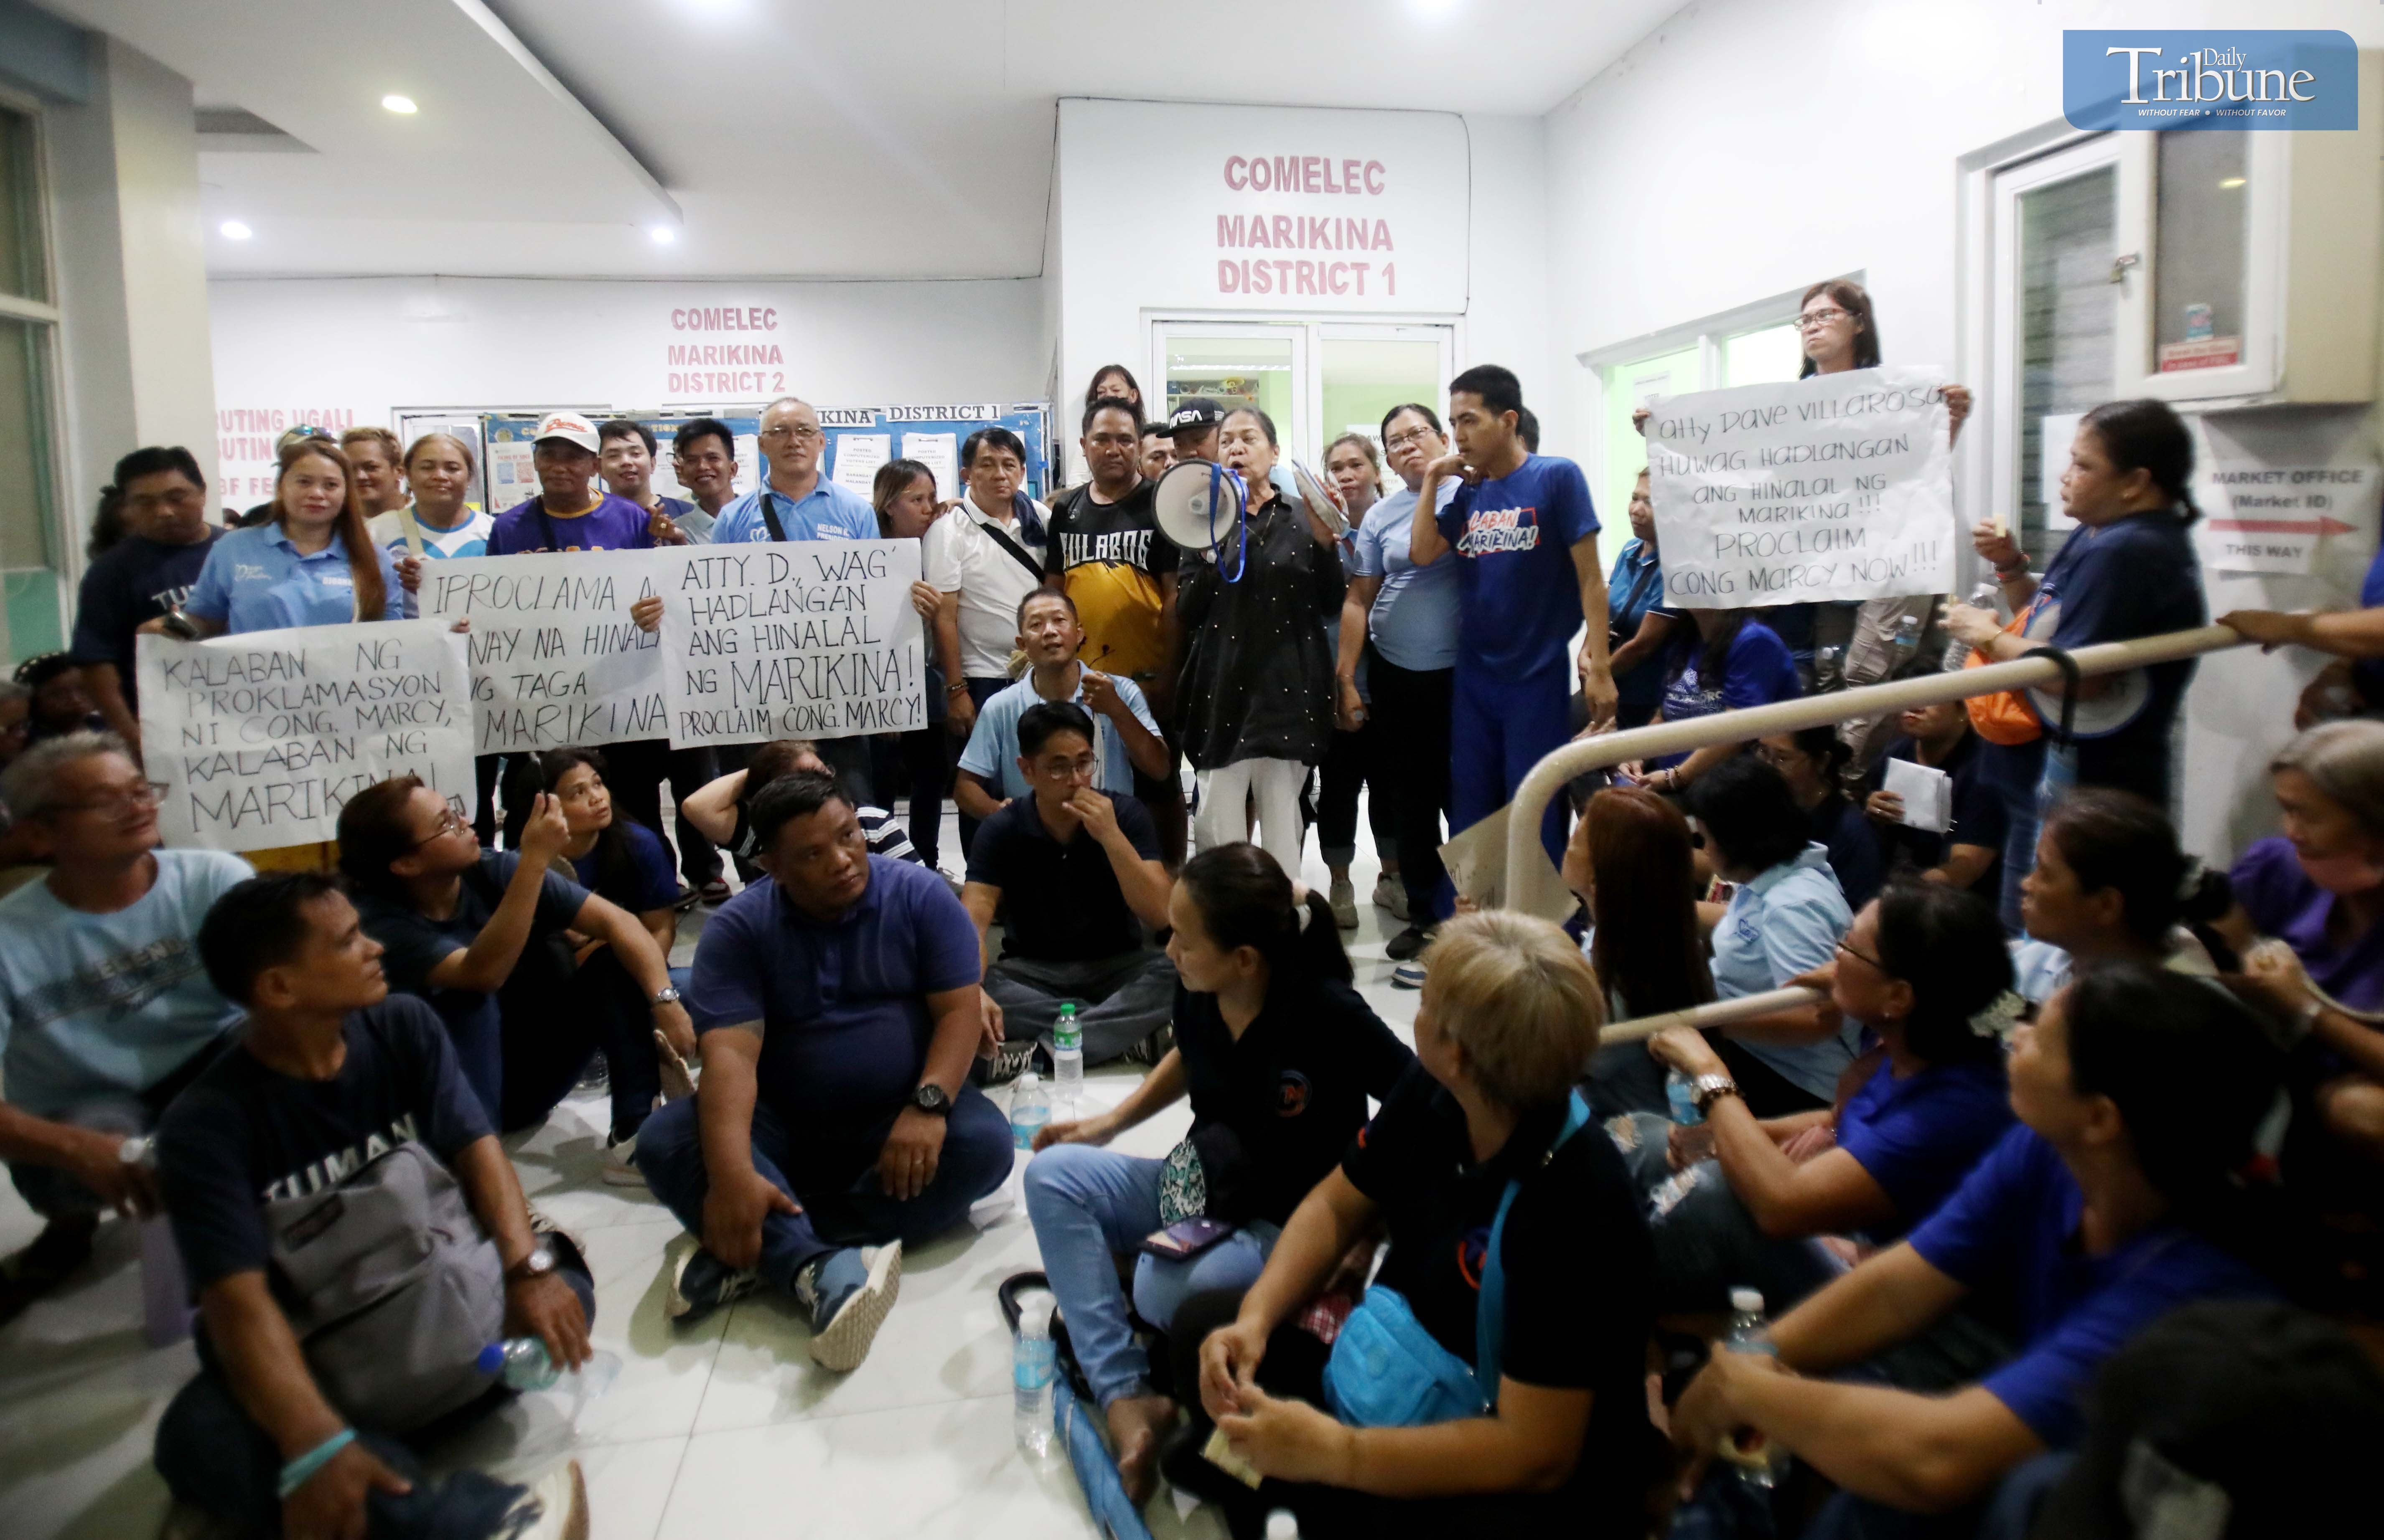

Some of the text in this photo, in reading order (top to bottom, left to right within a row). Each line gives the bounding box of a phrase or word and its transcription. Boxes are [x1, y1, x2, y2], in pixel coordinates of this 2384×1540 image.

[1224, 155, 1386, 196] COMELEC
[1217, 214, 1394, 252] MARIKINA
[1218, 259, 1395, 296] DISTRICT 1
[671, 307, 778, 331] COMELEC
[668, 344, 784, 366] MARIKINA
[668, 371, 786, 394] DISTRICT 2
[215, 409, 284, 433] UTING
[818, 405, 999, 424] KINA DISTRICT 1
[1169, 409, 1203, 429] NASA
[218, 438, 273, 461] UTIN
[1855, 472, 1887, 492] NG
[2212, 470, 2365, 485] MARKET OFFICE
[817, 523, 843, 535] NELSON
[1469, 507, 1521, 533] LABAN
[2226, 544, 2304, 558] THIS WAY
[433, 574, 616, 615] IPROCLAMA
[1670, 569, 1735, 596] CONG
[689, 584, 866, 626] HADLANGAN
[467, 628, 521, 667] NAY
[533, 627, 566, 660] NA
[689, 615, 881, 656] ANG HINALAL
[163, 638, 403, 691] KALABAN NG
[687, 644, 914, 709] NG MARIKINA!
[187, 673, 442, 718] PROKLAMASYON
[511, 671, 587, 699] TAGA
[182, 722, 219, 747] NI
[483, 693, 669, 749] MARIKINA
[679, 709, 772, 741] PROCLAIM
[184, 730, 427, 785] KALABAN NG
